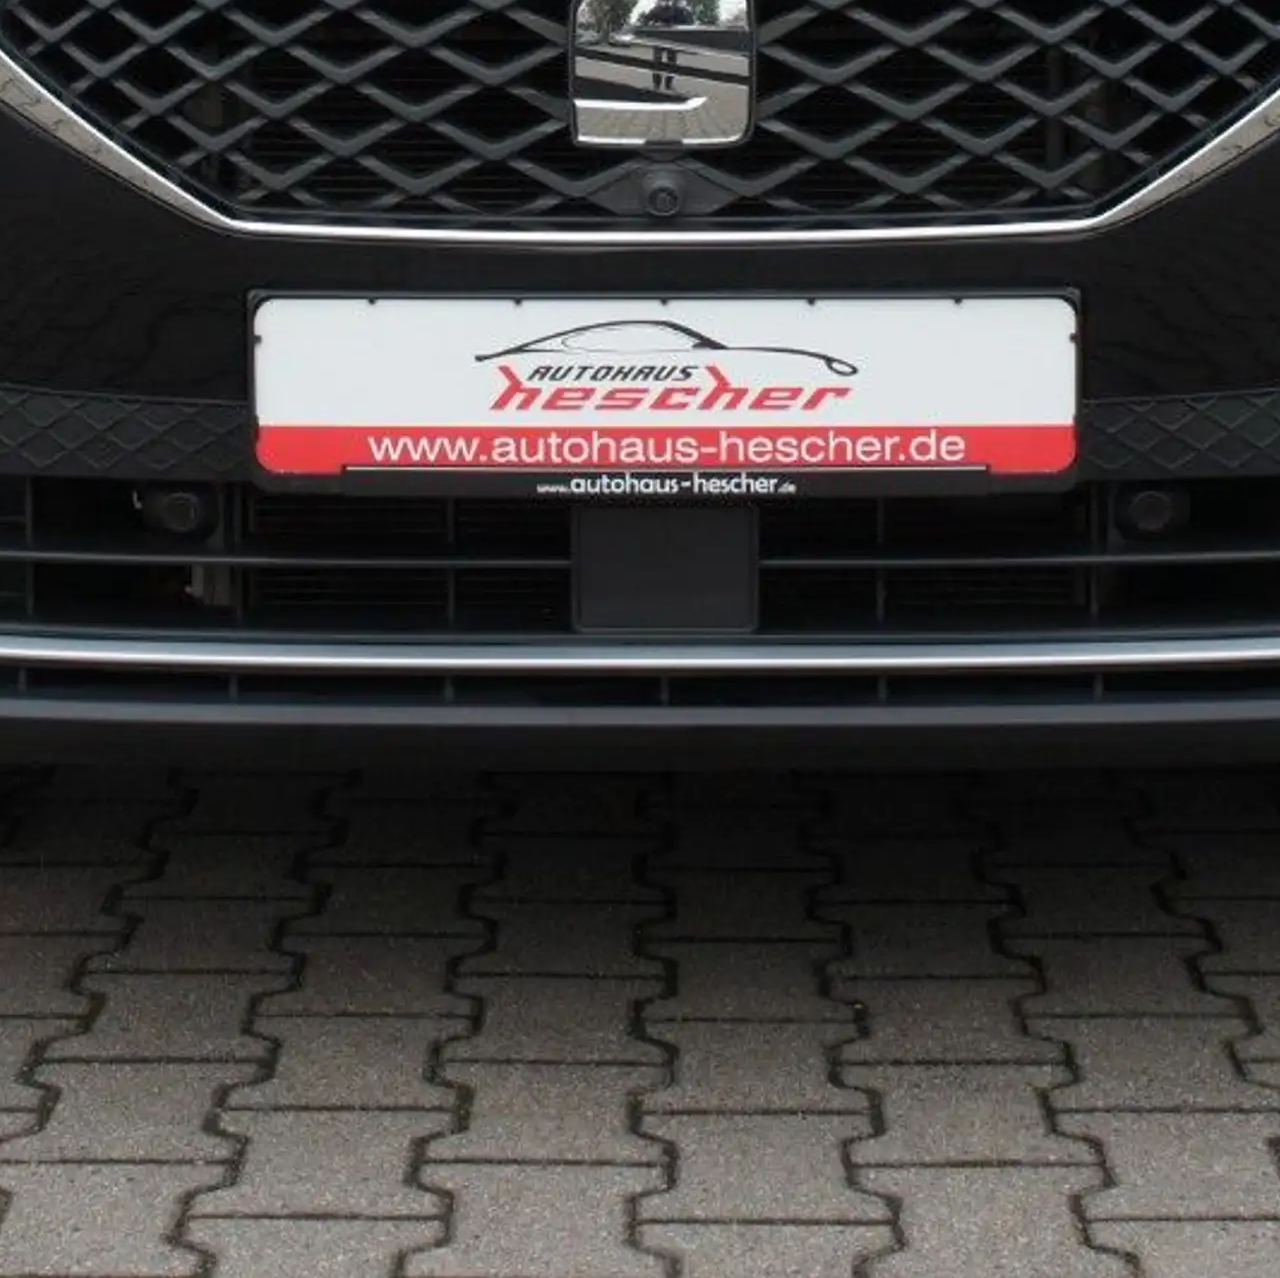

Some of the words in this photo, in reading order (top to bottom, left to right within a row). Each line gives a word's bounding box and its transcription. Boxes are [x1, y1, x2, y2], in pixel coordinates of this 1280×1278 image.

[527, 365, 699, 382] AUTOHAUS
[489, 365, 854, 411] hescher
[368, 429, 966, 463] www.autohaus-hescher.de
[536, 472, 797, 495] www.autohaus-hescher.de
